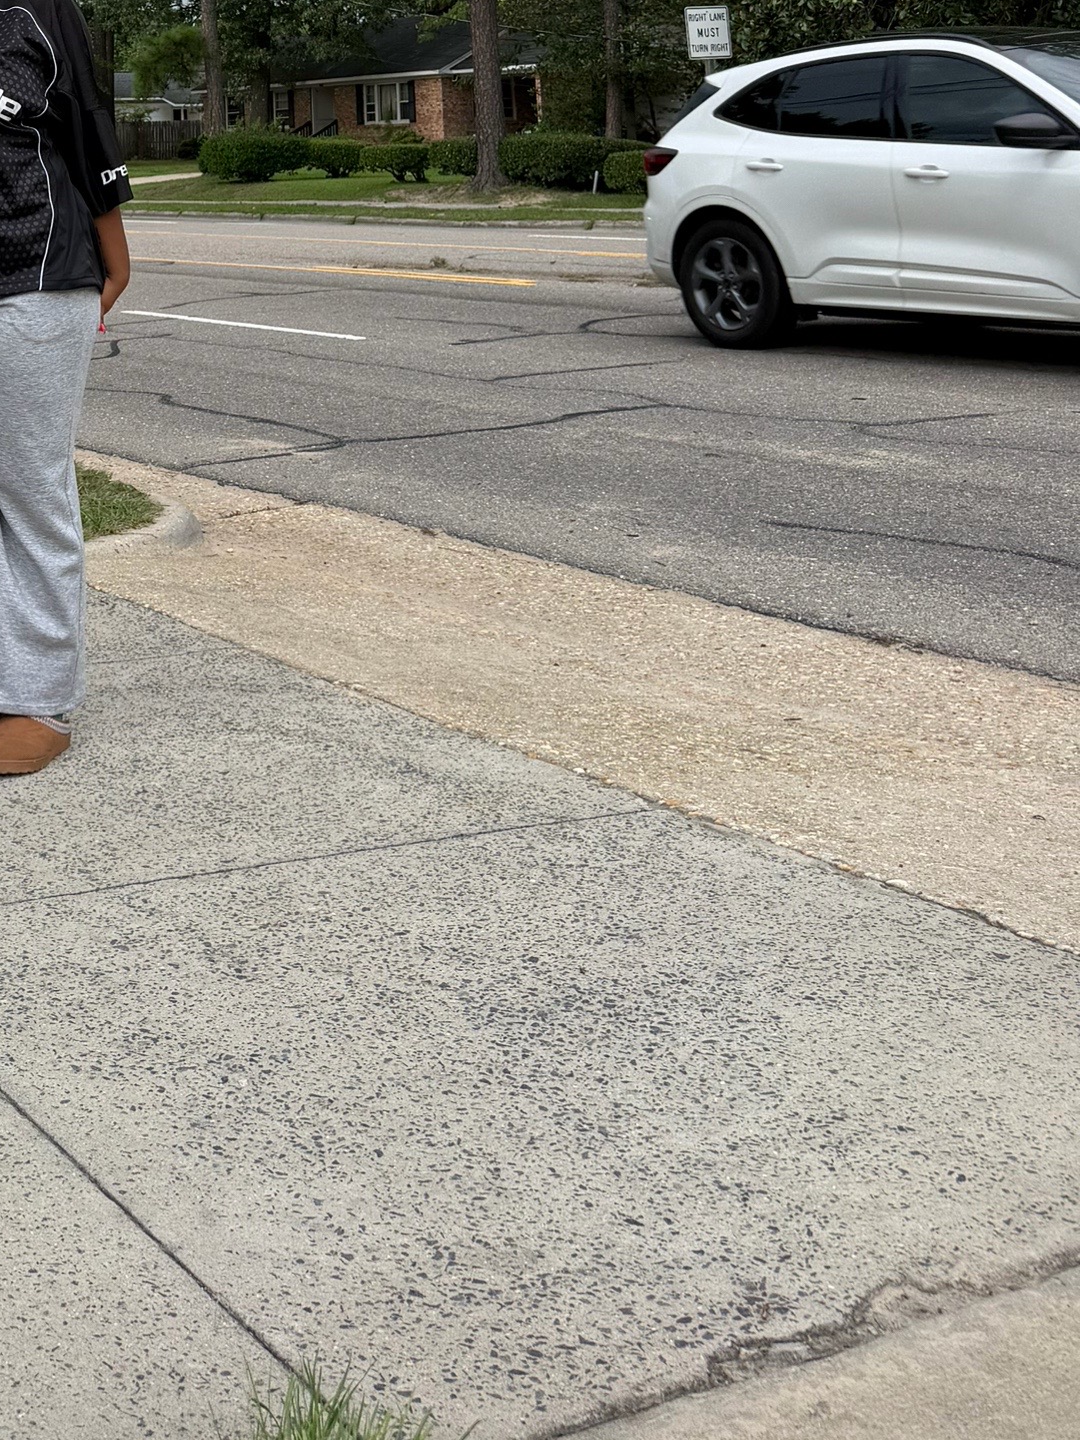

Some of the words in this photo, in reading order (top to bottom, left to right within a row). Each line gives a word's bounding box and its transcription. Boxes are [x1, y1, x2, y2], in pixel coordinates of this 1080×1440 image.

[688, 13, 707, 22] RIGHT
[709, 12, 726, 21] LANE
[697, 27, 720, 38] MUST
[691, 44, 709, 53] TURN
[710, 43, 728, 52] RIGHT
